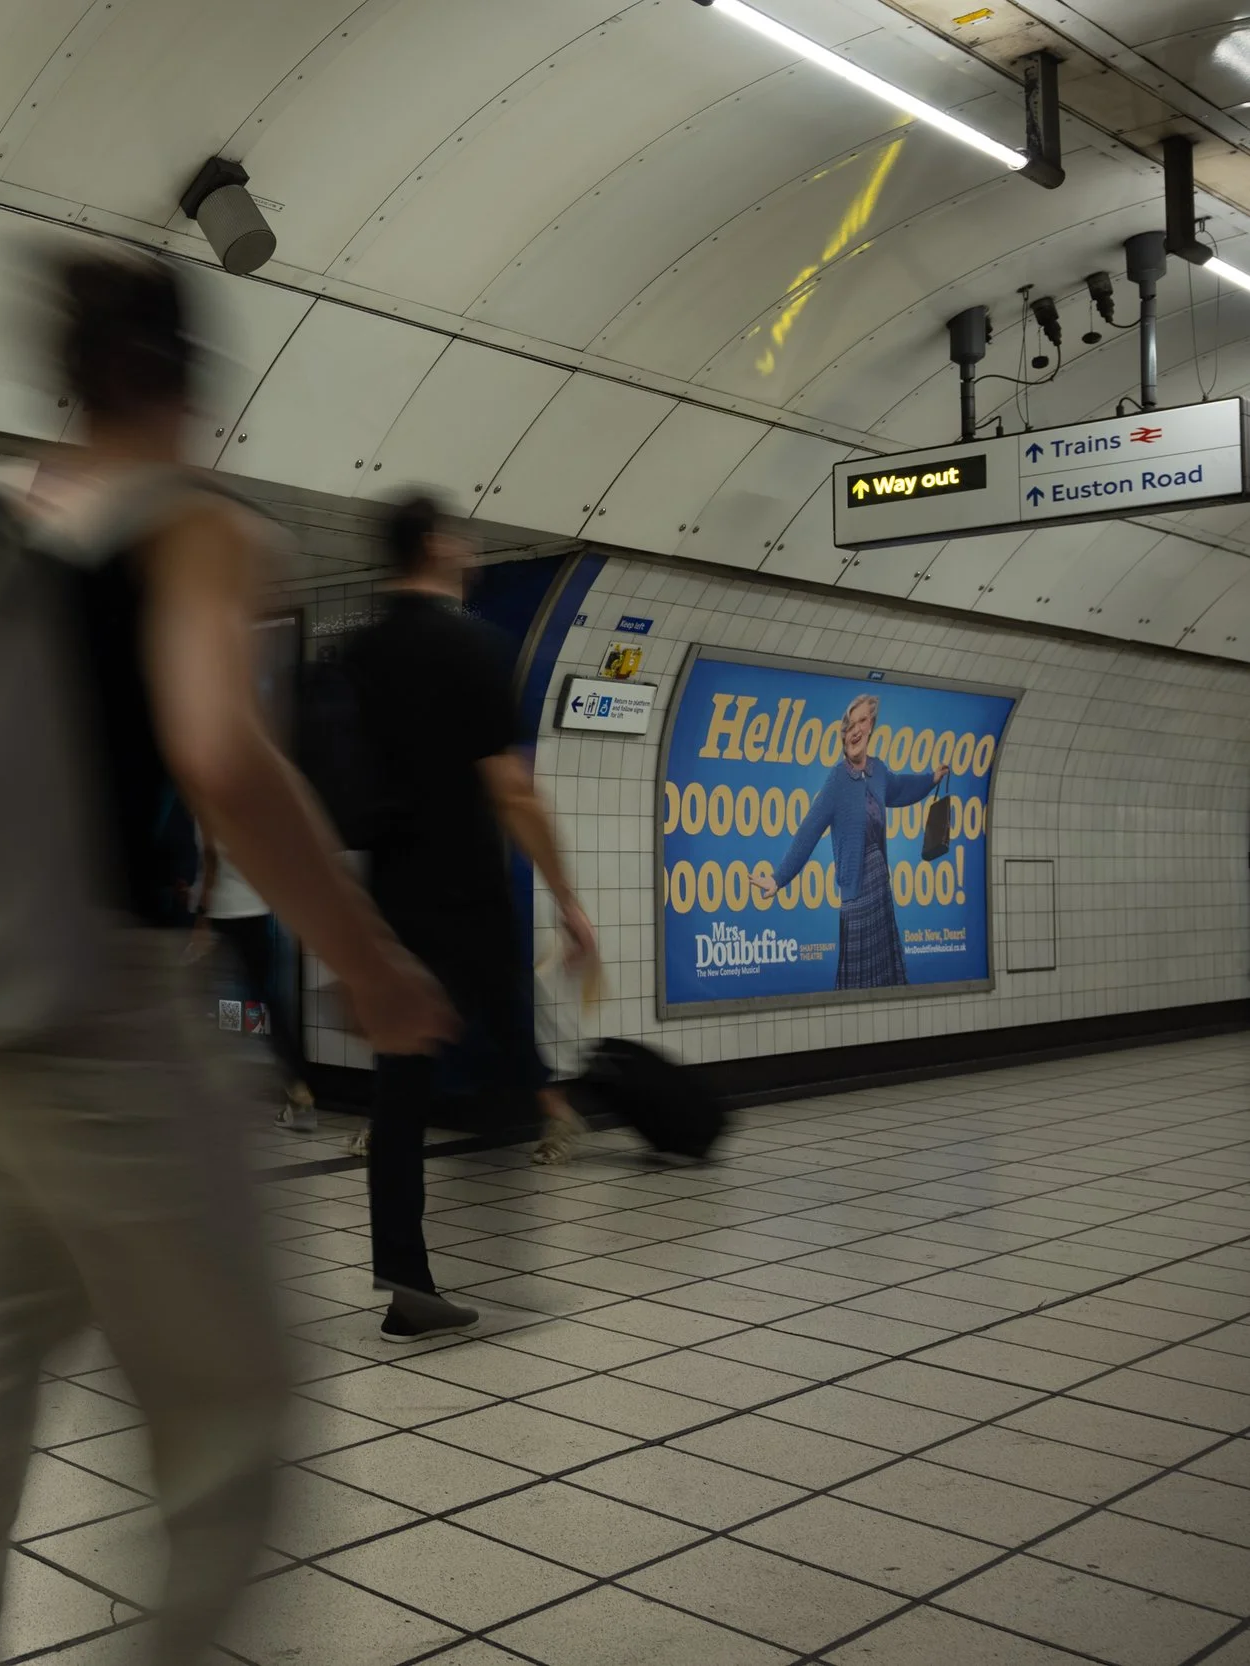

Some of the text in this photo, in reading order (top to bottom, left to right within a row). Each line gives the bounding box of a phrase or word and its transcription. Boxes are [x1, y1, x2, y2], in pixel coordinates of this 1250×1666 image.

[1051, 435, 1121, 458] Trains
[872, 467, 959, 495] Way out
[1052, 464, 1203, 502] Euston Road
[620, 620, 646, 630] Keep left
[712, 922, 740, 942] Mrs.
[904, 928, 923, 943] Book
[695, 928, 798, 968] Doubtfire
[696, 965, 760, 977] The New Comedy Musical
